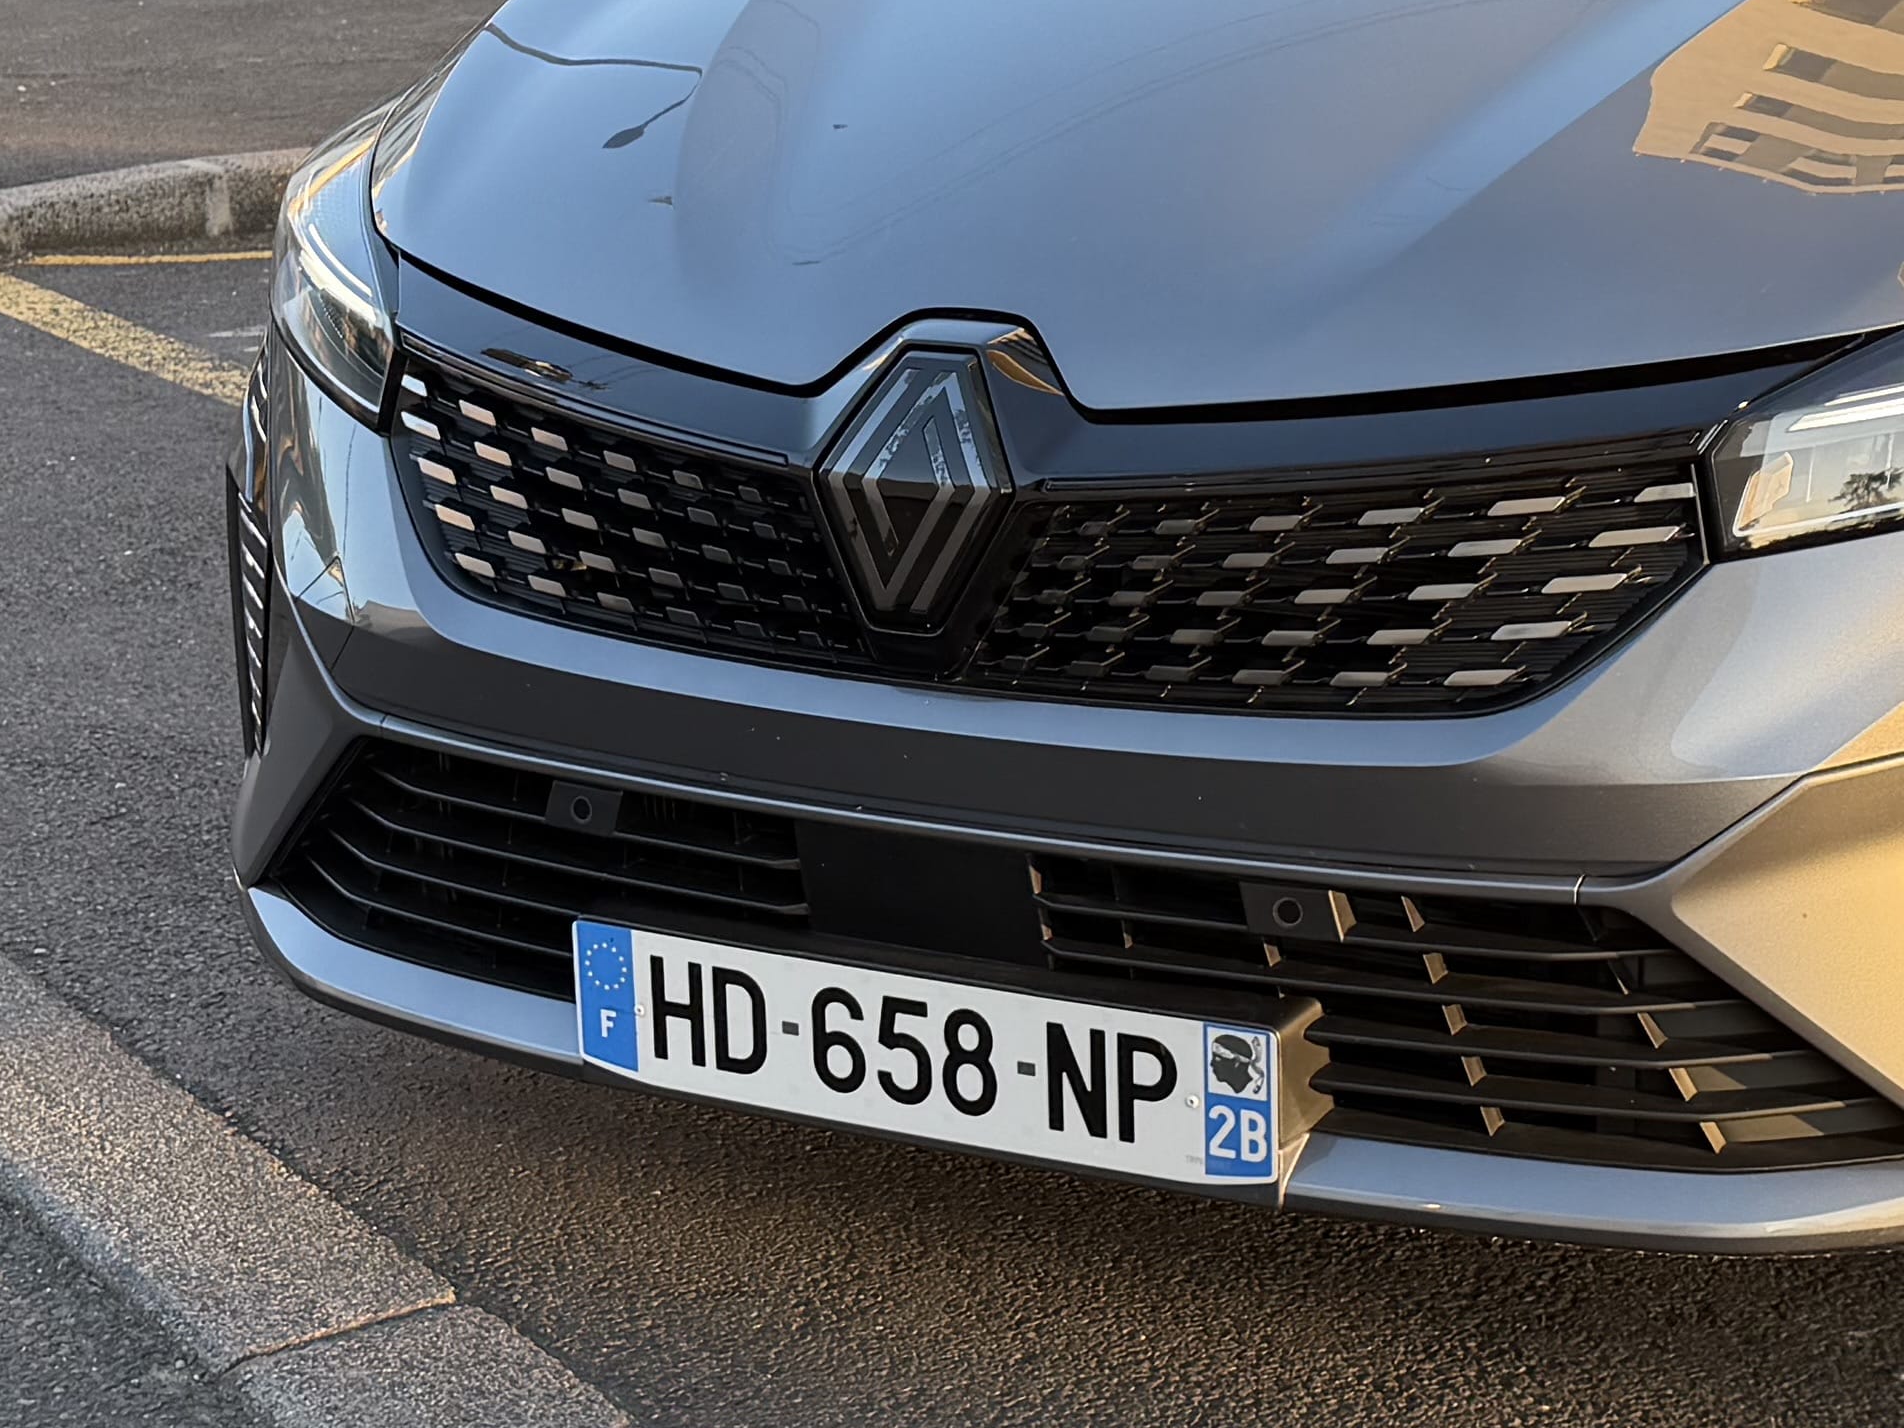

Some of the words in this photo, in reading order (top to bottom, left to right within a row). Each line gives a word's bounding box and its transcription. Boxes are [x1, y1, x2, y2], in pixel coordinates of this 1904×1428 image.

[600, 1008, 617, 1038] F
[649, 954, 1178, 1143] HD-658-NP
[1208, 1105, 1268, 1163] 2B
